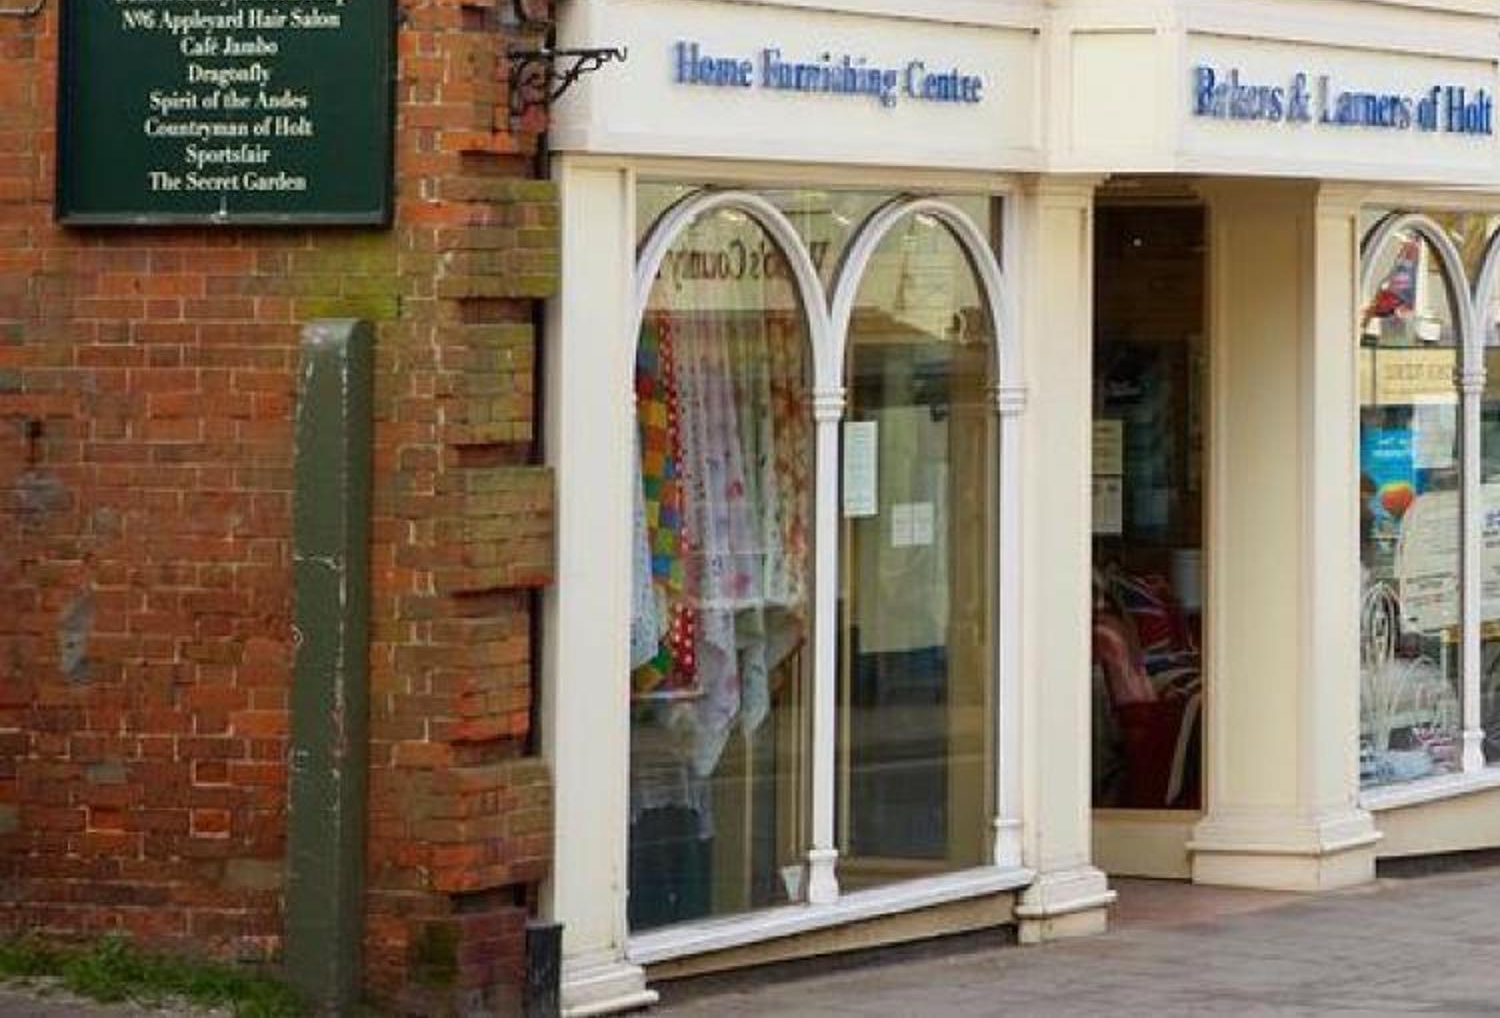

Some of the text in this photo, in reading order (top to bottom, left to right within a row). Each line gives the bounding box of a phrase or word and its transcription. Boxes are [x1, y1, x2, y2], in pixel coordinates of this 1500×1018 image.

[158, 8, 244, 35] Appleyard
[248, 8, 287, 28] Hair
[290, 7, 341, 28] Salon
[180, 36, 279, 56] Café Jambo
[188, 62, 270, 88] Dragonfly
[673, 39, 983, 109] Home Furnishing Centre
[150, 90, 308, 117] Spirit of the Andes
[1192, 65, 1494, 136] Bakers & Larners of Holt
[144, 115, 314, 141] Countryman of Holt
[186, 143, 271, 170] Sportsfair
[149, 171, 307, 191] The Secret Garden
